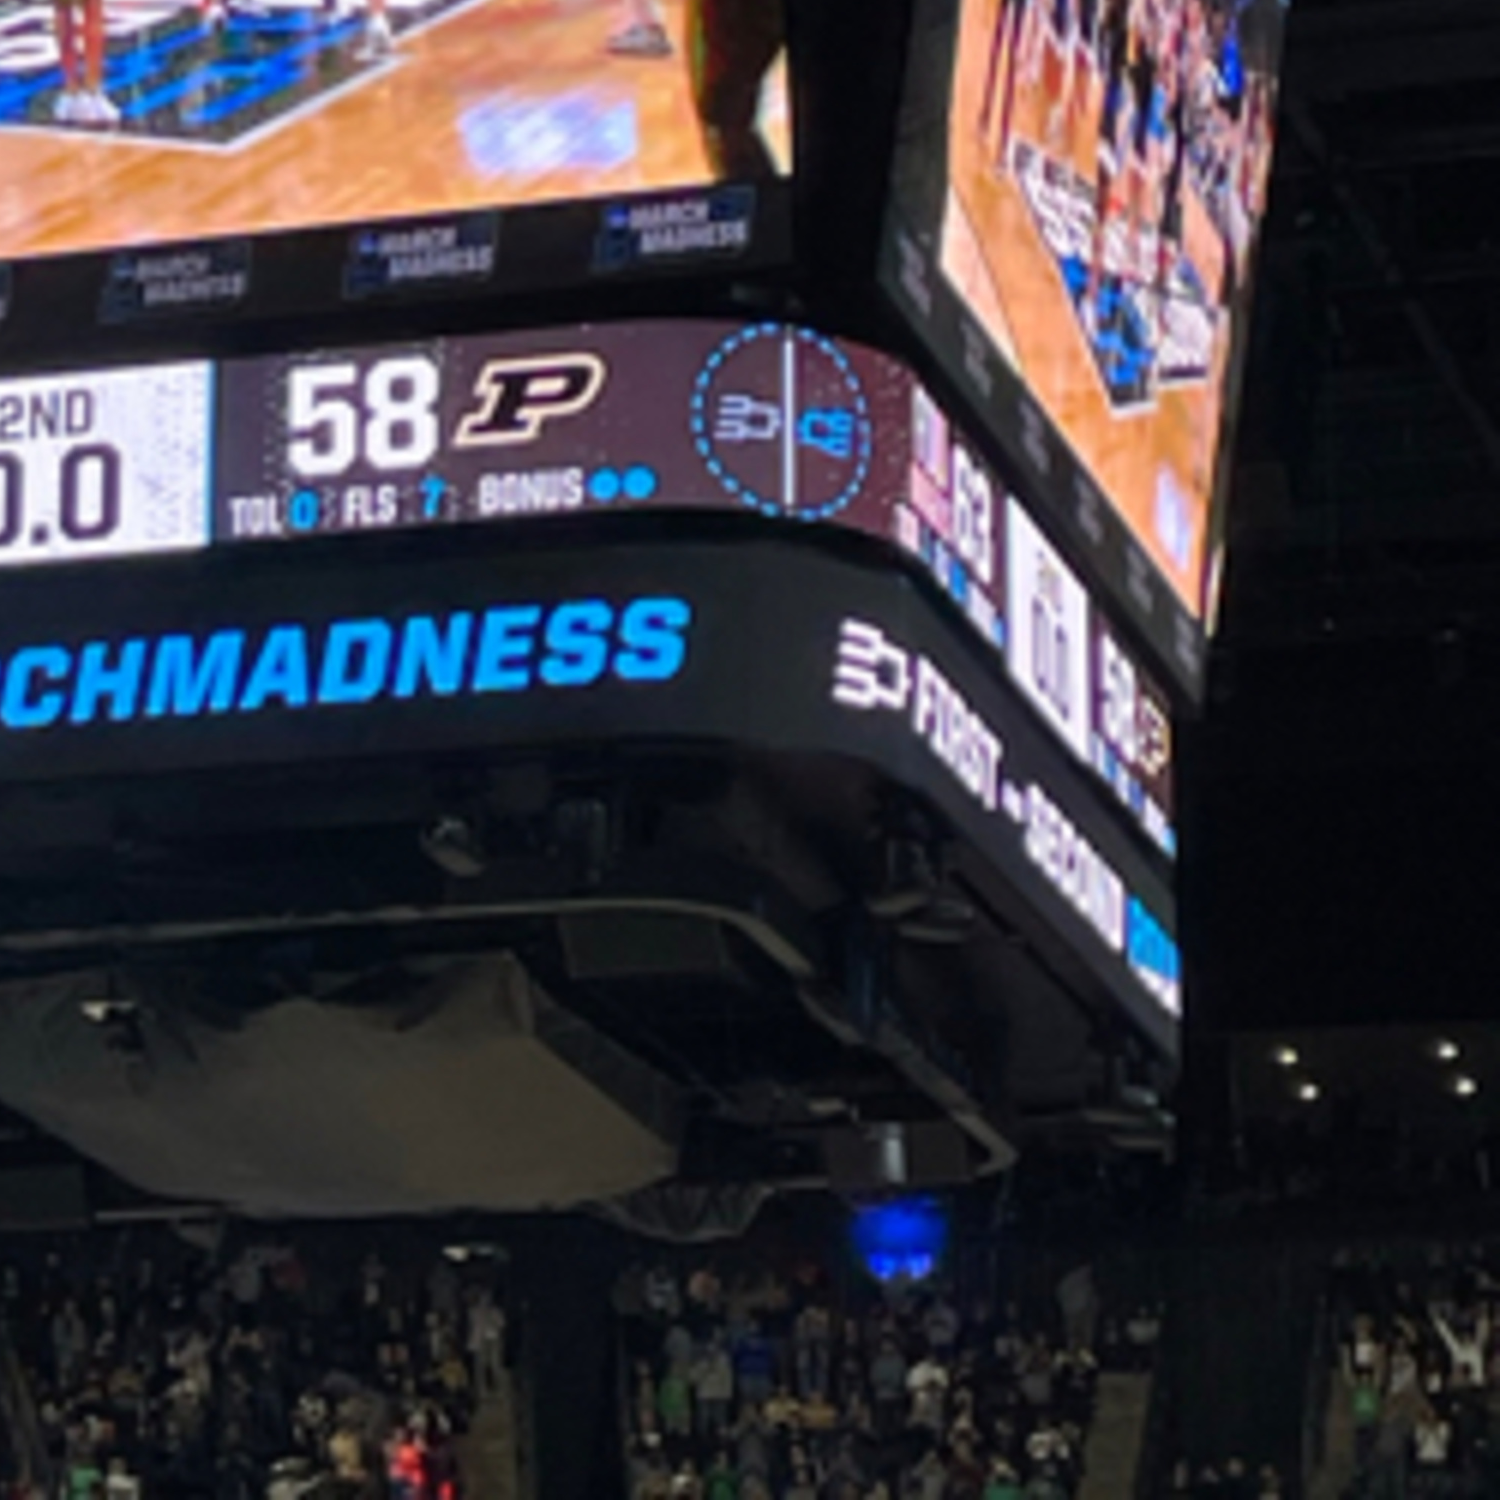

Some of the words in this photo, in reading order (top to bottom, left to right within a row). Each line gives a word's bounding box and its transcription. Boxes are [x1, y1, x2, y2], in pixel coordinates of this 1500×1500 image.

[287, 356, 439, 476] 58
[229, 495, 283, 537] TOL
[289, 489, 320, 530] 0
[343, 485, 396, 525] FLS
[422, 475, 444, 518] 7
[479, 468, 583, 515] BONUS
[913, 654, 1002, 812] FIRST
